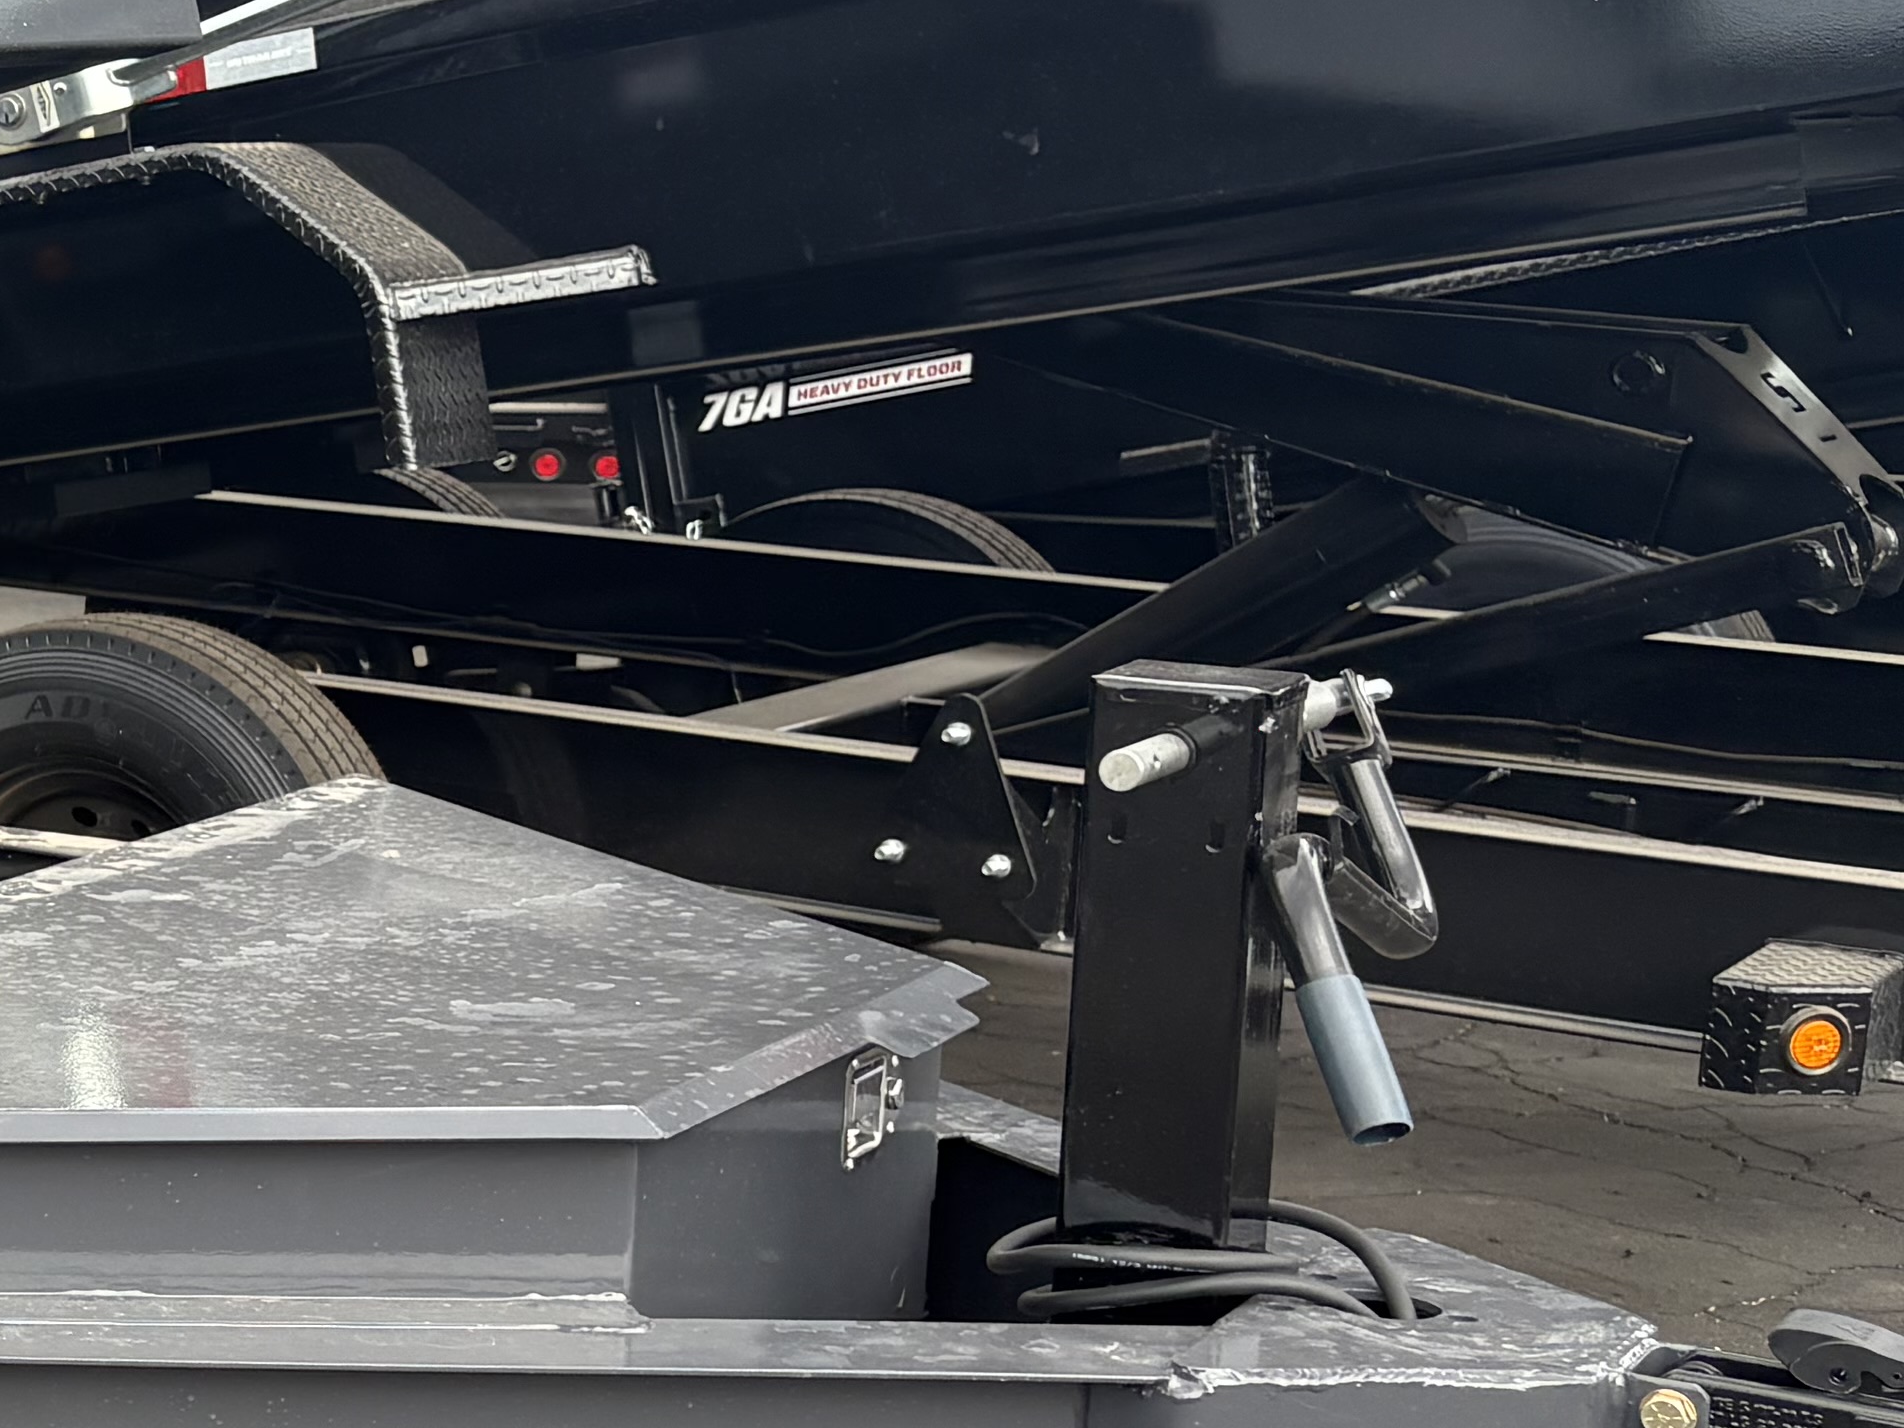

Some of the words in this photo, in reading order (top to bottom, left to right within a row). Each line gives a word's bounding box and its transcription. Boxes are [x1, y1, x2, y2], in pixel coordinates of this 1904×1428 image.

[797, 379, 853, 401] HEAVY
[857, 371, 903, 391] DUTY
[906, 360, 963, 381] FLOOR
[698, 381, 786, 432] 7GA
